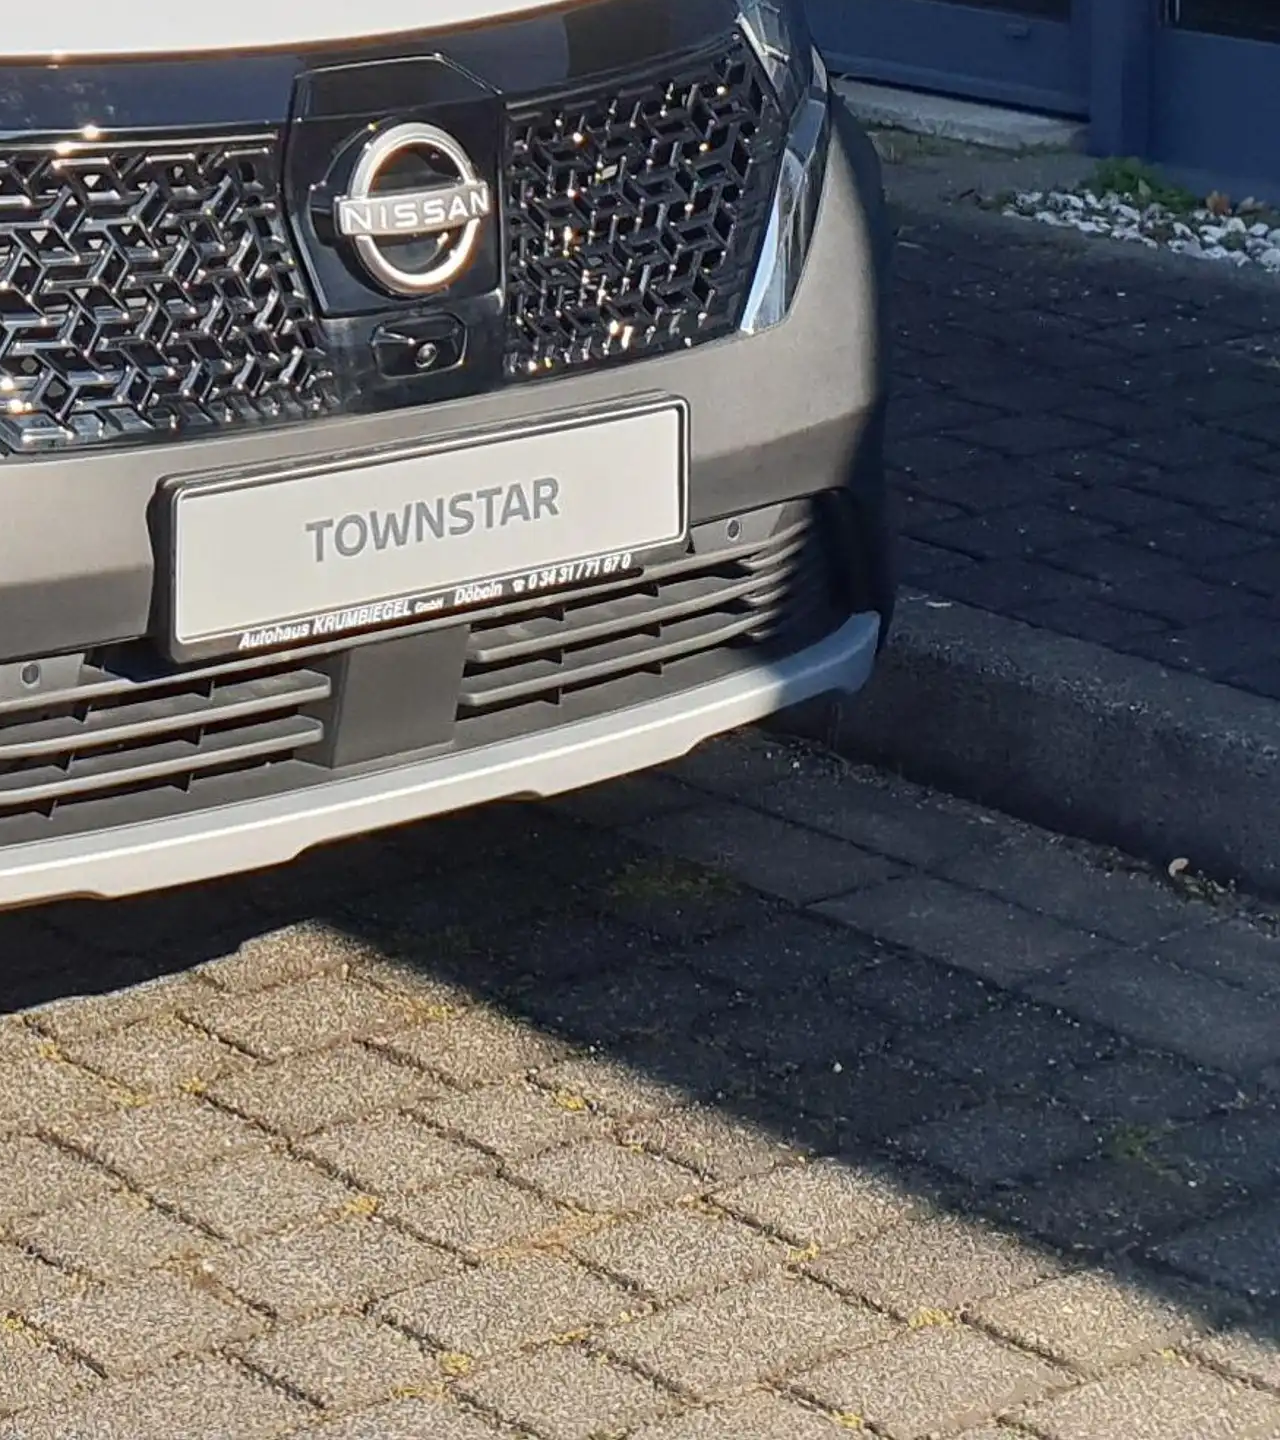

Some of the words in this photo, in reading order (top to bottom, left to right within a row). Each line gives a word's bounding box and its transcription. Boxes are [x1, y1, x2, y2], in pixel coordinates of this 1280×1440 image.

[344, 186, 490, 231] NISSAN
[305, 477, 559, 563] TOWNSTAR
[239, 623, 311, 650] Autohaus
[312, 599, 413, 636] KRUMBIEGEL
[454, 581, 503, 606] Döbeln
